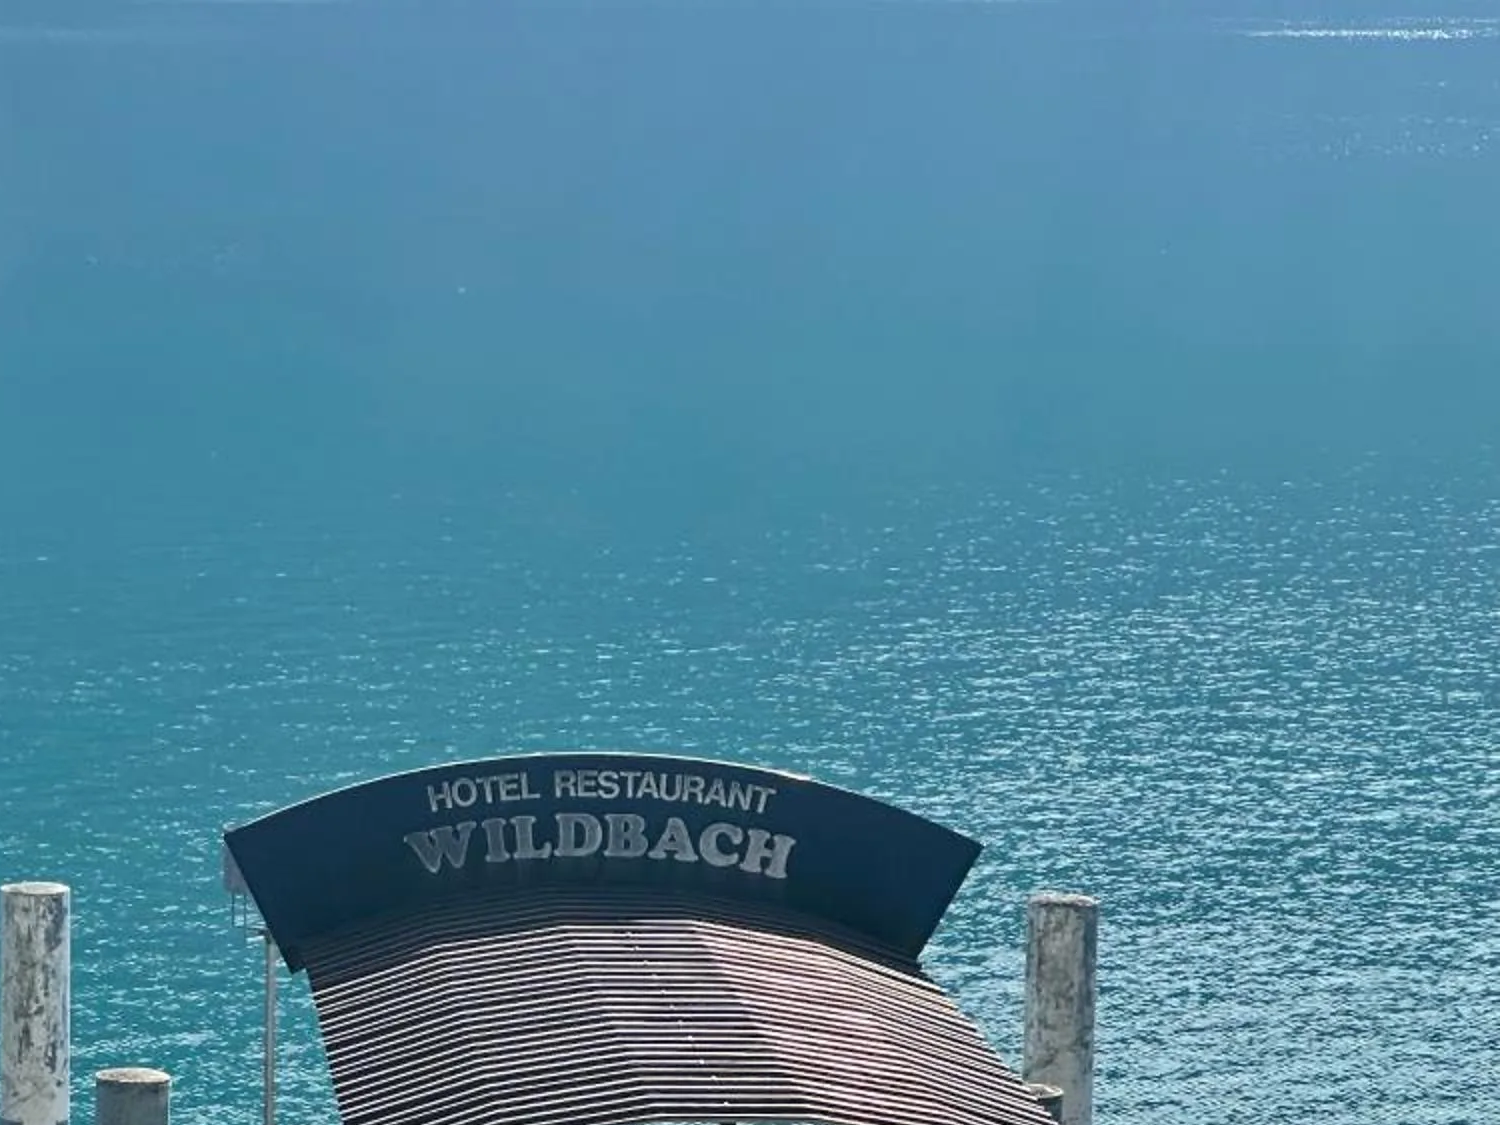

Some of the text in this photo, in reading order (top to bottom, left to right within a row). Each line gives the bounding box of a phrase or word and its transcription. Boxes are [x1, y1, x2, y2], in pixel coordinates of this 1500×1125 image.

[428, 770, 776, 814] HOTEL RESTAURANT
[404, 814, 796, 880] WILDBACH
